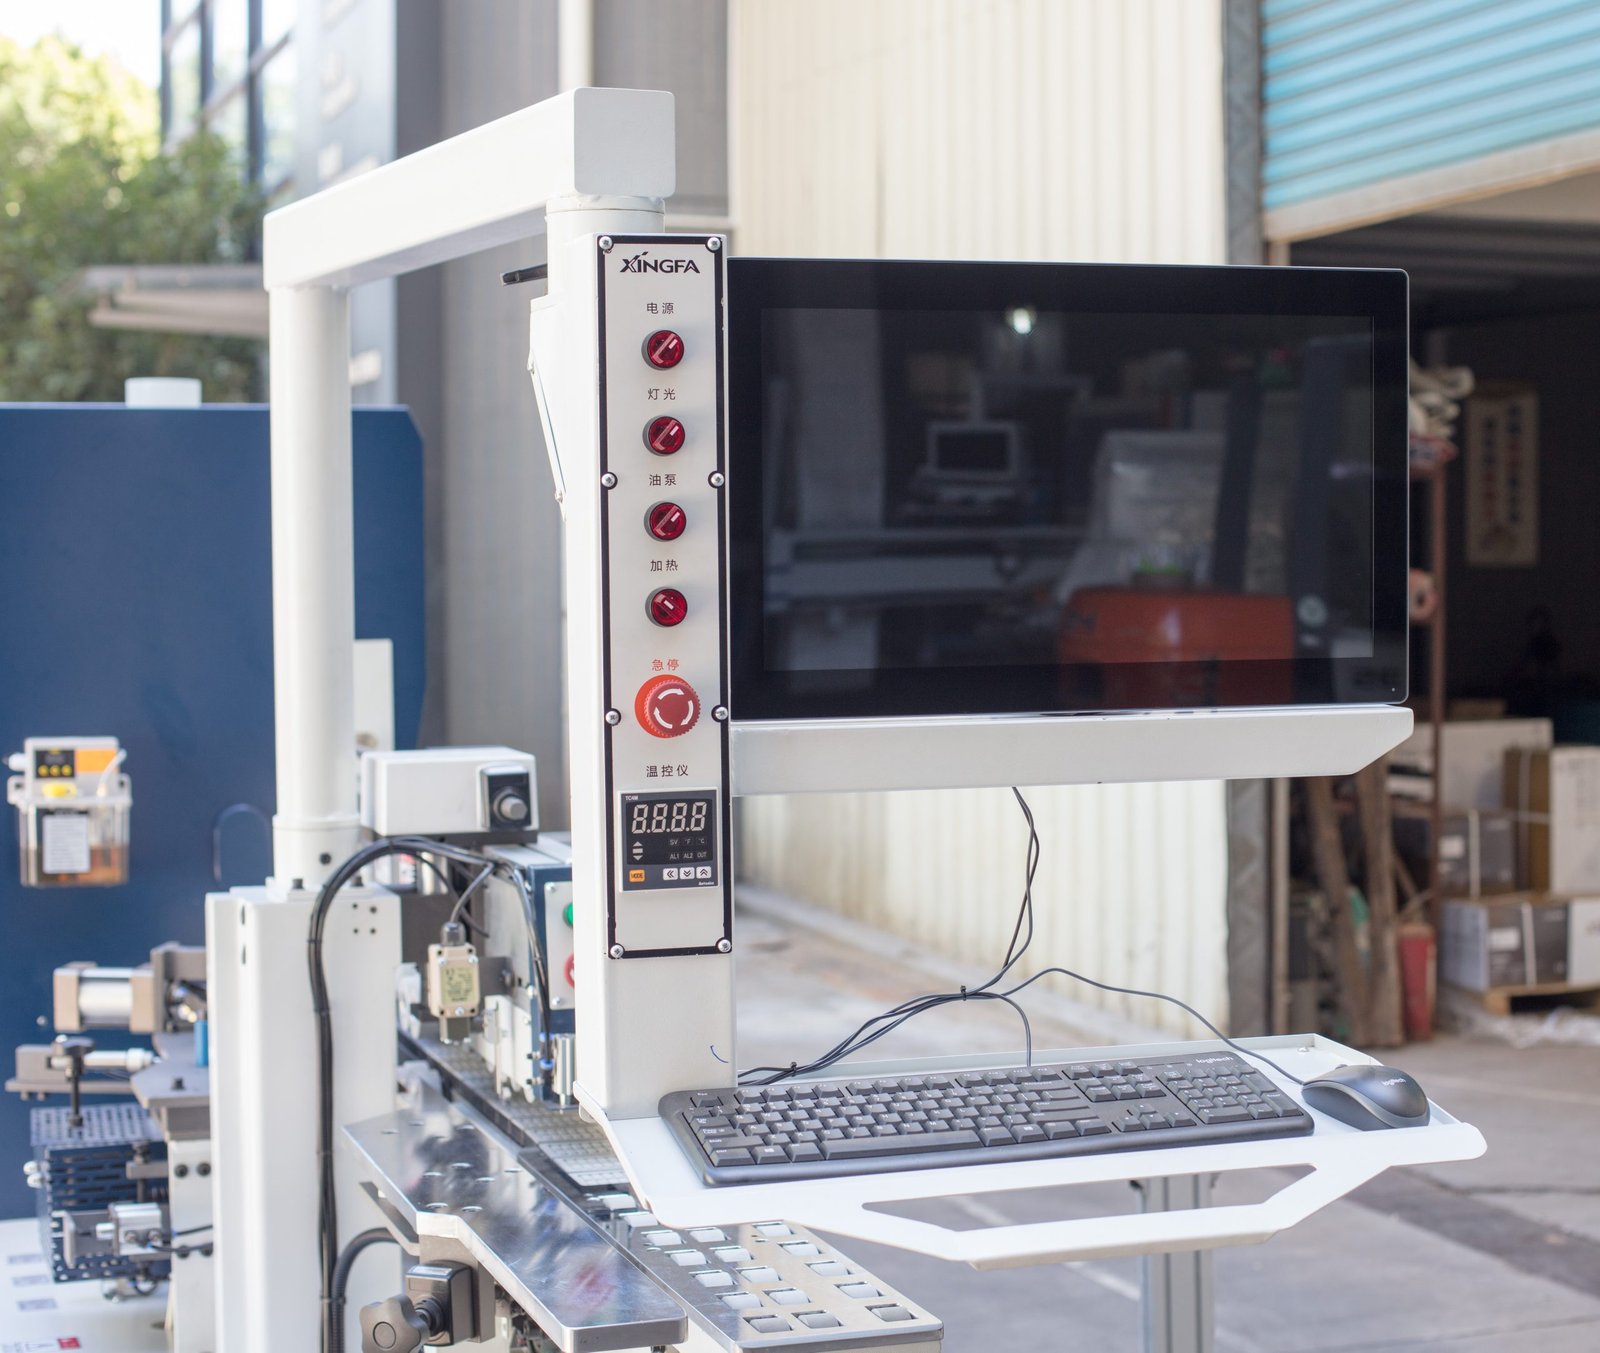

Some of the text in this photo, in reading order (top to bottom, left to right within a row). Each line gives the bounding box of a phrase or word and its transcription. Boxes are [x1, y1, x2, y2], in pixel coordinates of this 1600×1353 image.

[620, 252, 700, 274] XINGFA
[646, 302, 675, 315] 电源
[647, 388, 676, 401] 灯光
[649, 474, 677, 486] 油泵
[650, 559, 679, 572] 加热
[651, 659, 680, 671] 急停
[646, 764, 689, 777] 温控仪
[1195, 1056, 1234, 1064] logitech
